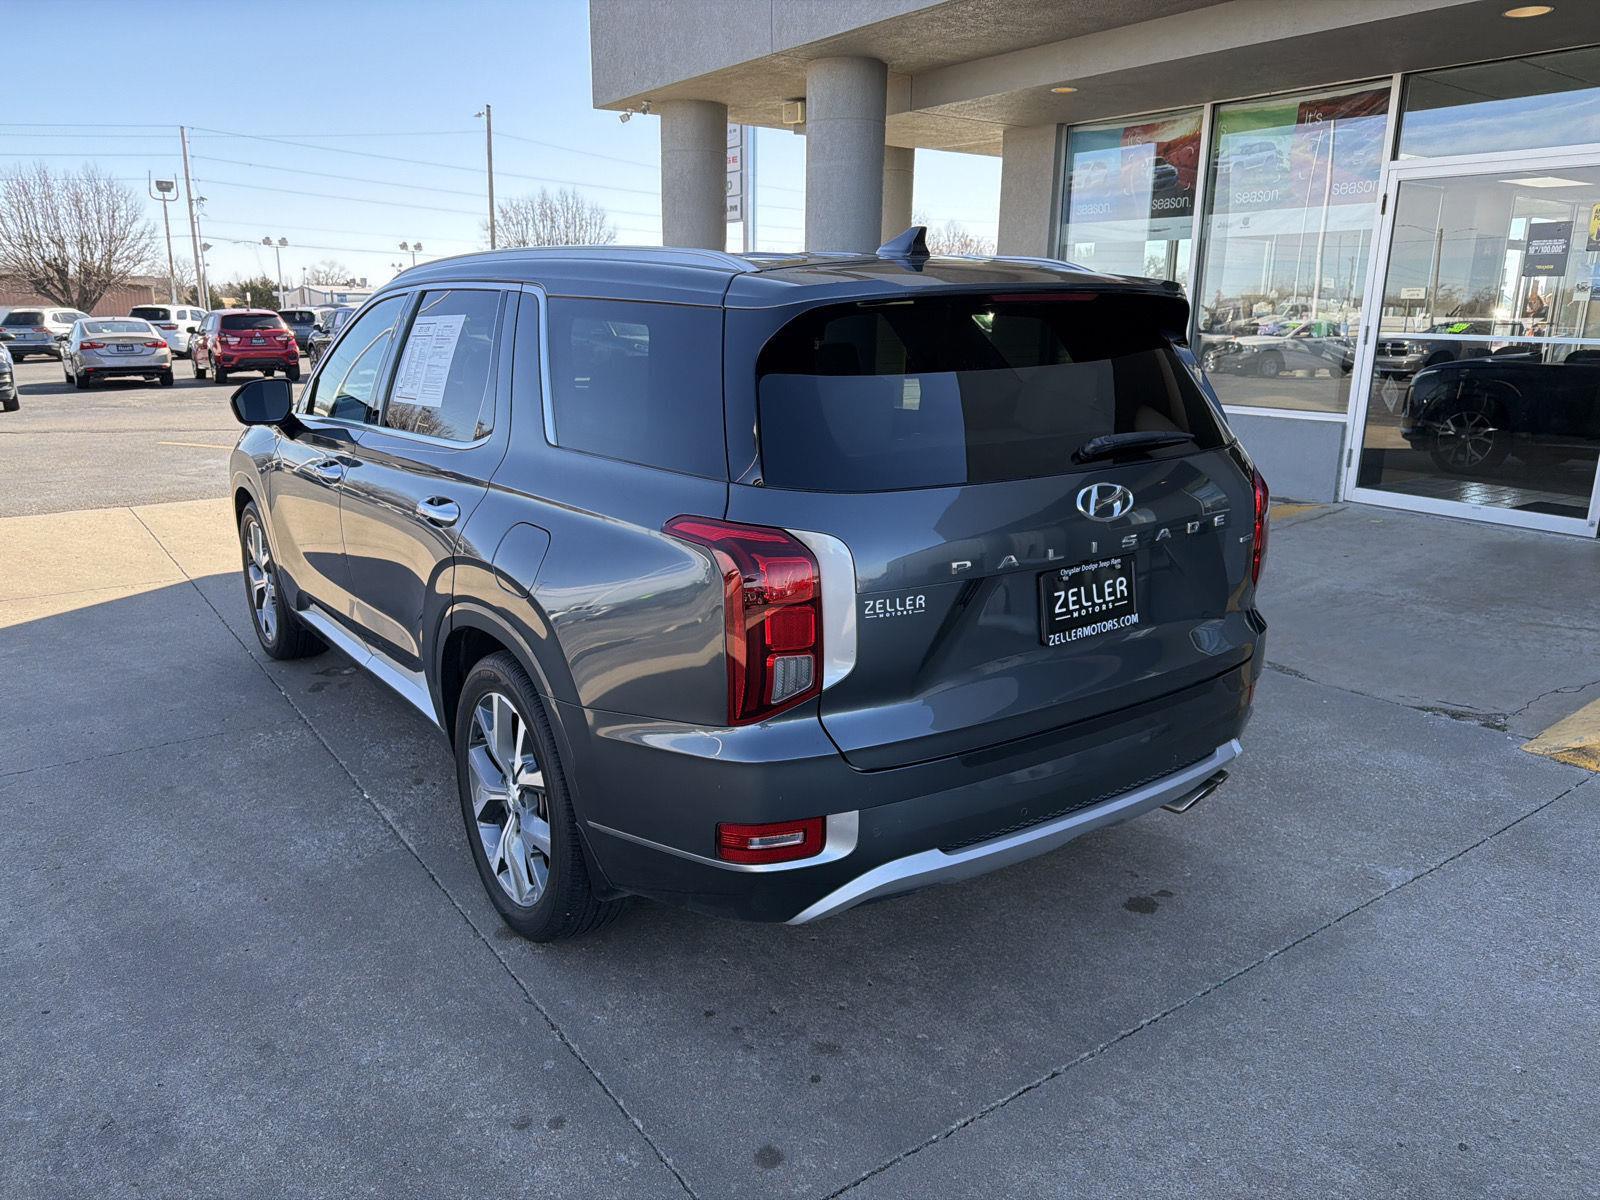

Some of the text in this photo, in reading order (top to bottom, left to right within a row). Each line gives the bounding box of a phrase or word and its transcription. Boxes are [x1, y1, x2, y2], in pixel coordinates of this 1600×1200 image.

[1304, 109, 1324, 126] It's
[1151, 196, 1192, 210] season.
[950, 513, 1226, 576] PALISADE
[1060, 565, 1081, 577] Chrysler
[1082, 563, 1098, 573] Dodge
[1099, 560, 1111, 569] Jeep
[1054, 576, 1128, 614] ZELLER
[864, 595, 926, 615] ZELLER
[1072, 602, 1114, 618] MOTORS
[879, 610, 913, 618] MOTORS
[1049, 613, 1139, 646] ZELLERMOTORS.COM
